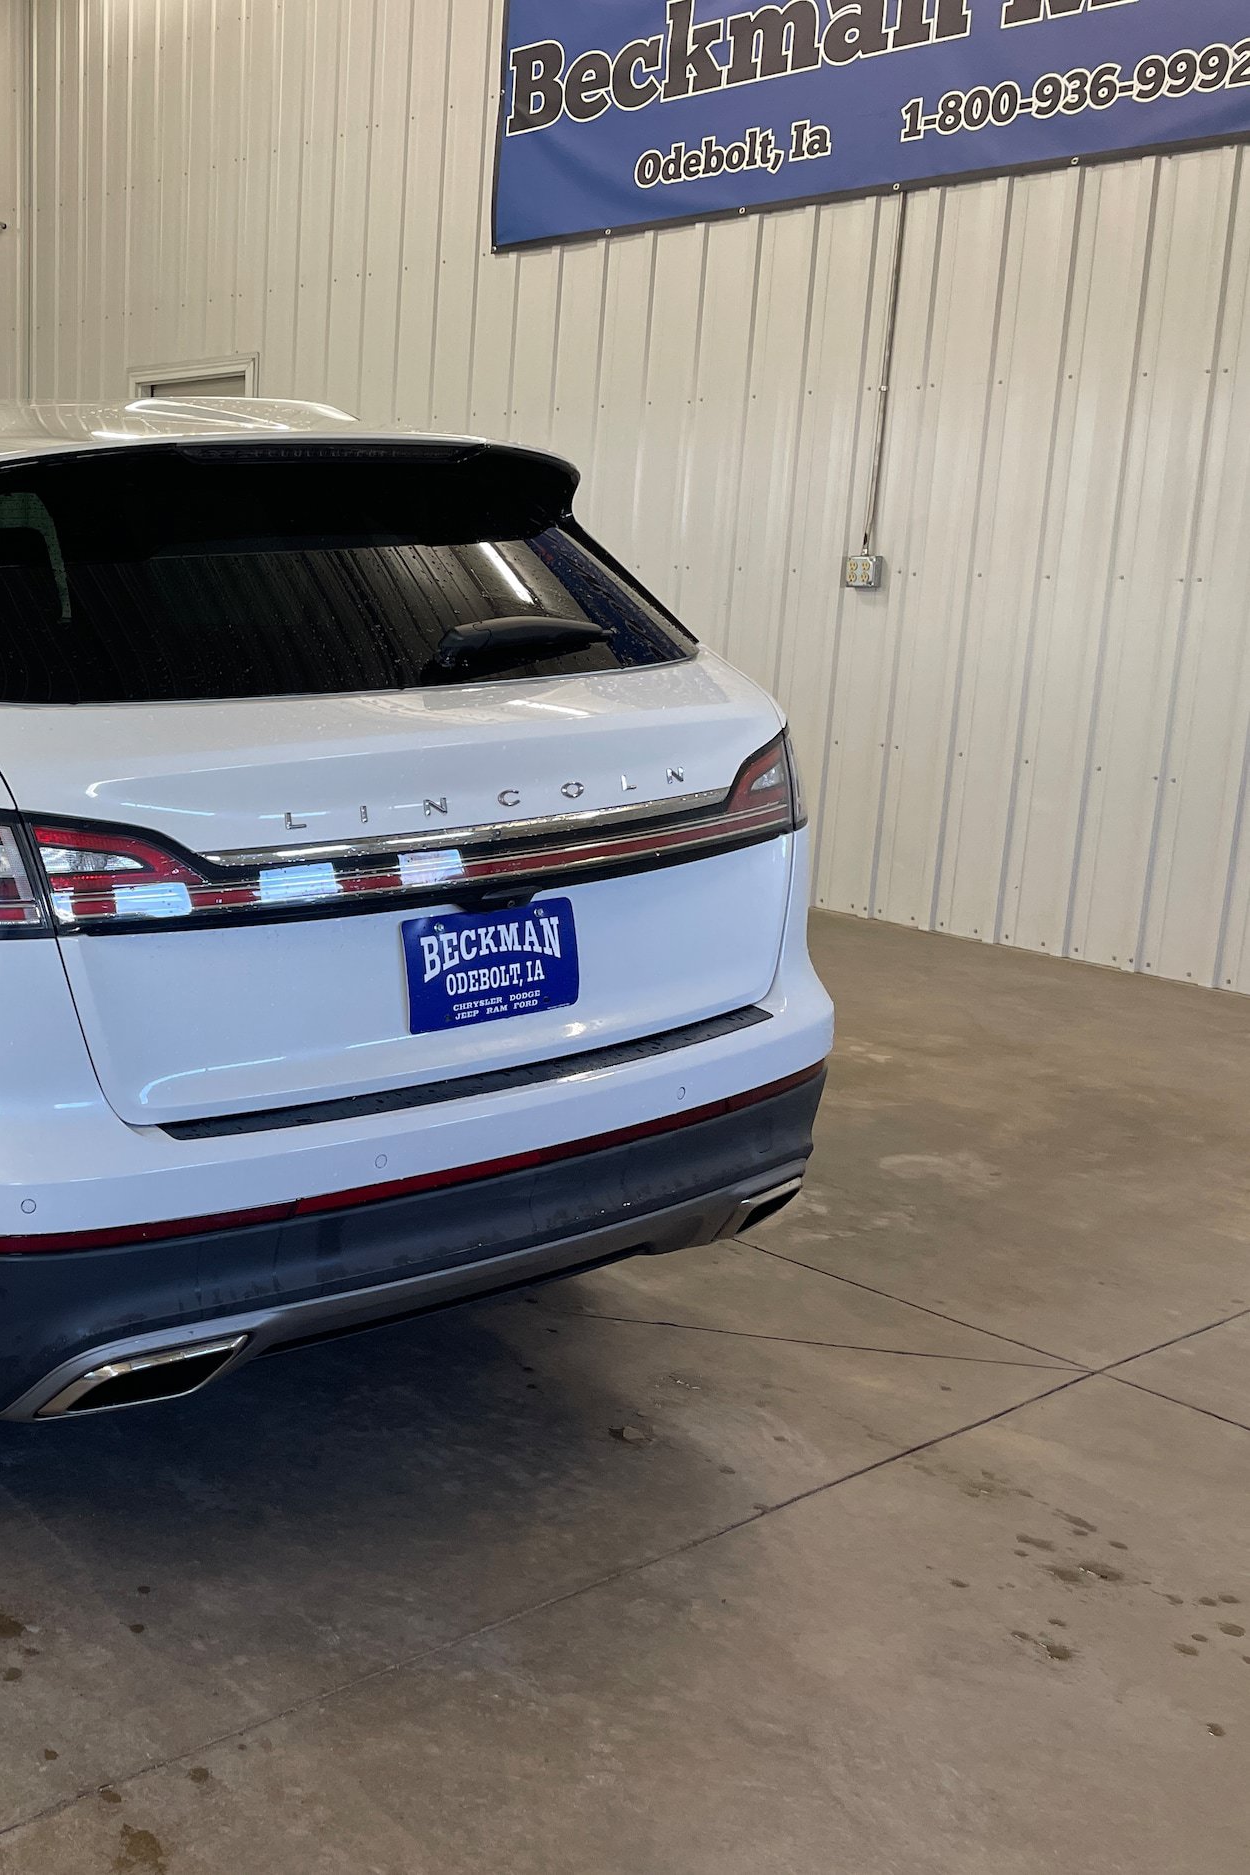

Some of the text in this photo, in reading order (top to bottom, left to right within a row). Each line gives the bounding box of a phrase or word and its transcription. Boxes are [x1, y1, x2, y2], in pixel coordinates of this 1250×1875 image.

[506, 0, 972, 137] Beckman
[900, 37, 1250, 143] 1-800-936-9992
[635, 120, 832, 188] Odebolt, Ia
[284, 766, 685, 830] LINCOLN
[420, 916, 562, 983] BECKMAN
[446, 959, 546, 996] ODEBOLT, IA
[452, 989, 541, 1012] CHRYSLER DODGE
[454, 1009, 480, 1021] JEEP
[486, 1003, 508, 1015] RAM
[513, 999, 538, 1010] FORD
